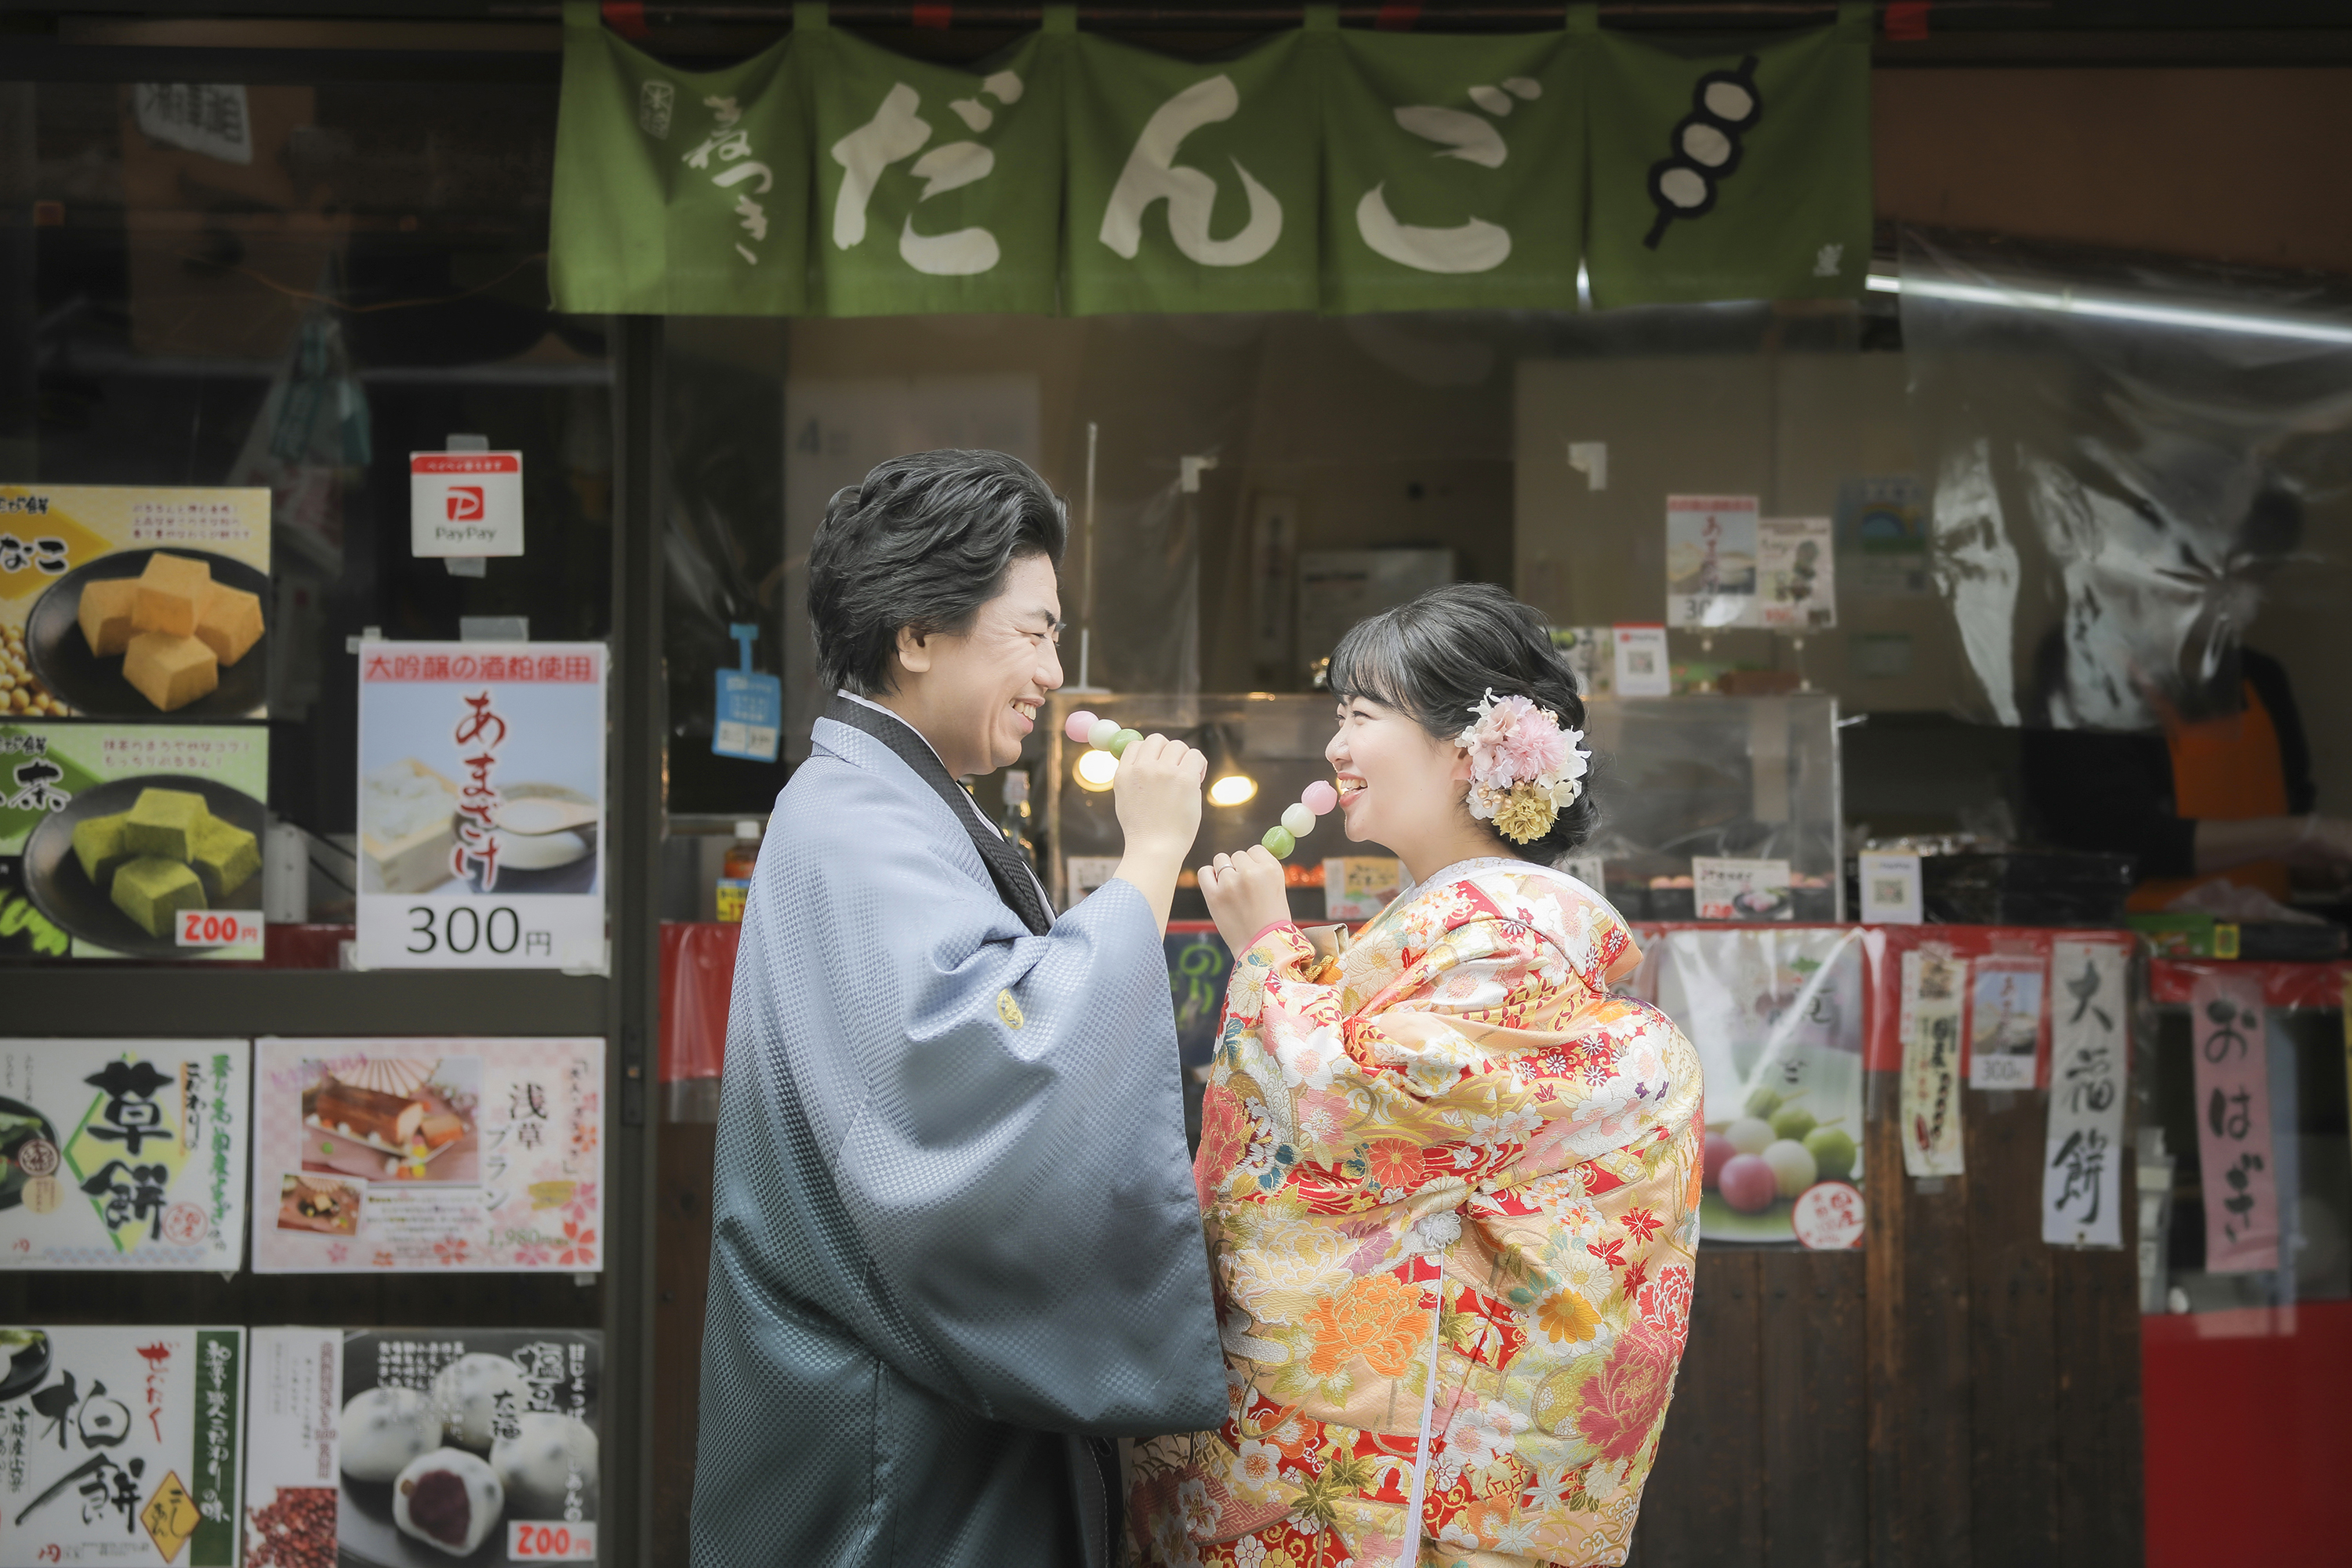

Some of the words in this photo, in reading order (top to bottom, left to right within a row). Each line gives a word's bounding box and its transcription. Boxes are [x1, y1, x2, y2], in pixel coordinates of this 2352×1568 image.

[831, 70, 1542, 275] だんご
[436, 526, 497, 543] PayPay
[452, 690, 506, 891] あまざけ
[184, 913, 258, 942] 200円
[405, 907, 551, 955] 300円
[81, 1061, 174, 1240] 草餅
[509, 1082, 548, 1150] 浅草
[2052, 959, 2114, 1225] 大福餅
[2204, 999, 2264, 1243] おはぎ
[15, 1368, 144, 1534] 柏餅
[517, 1525, 591, 1555] 200円
